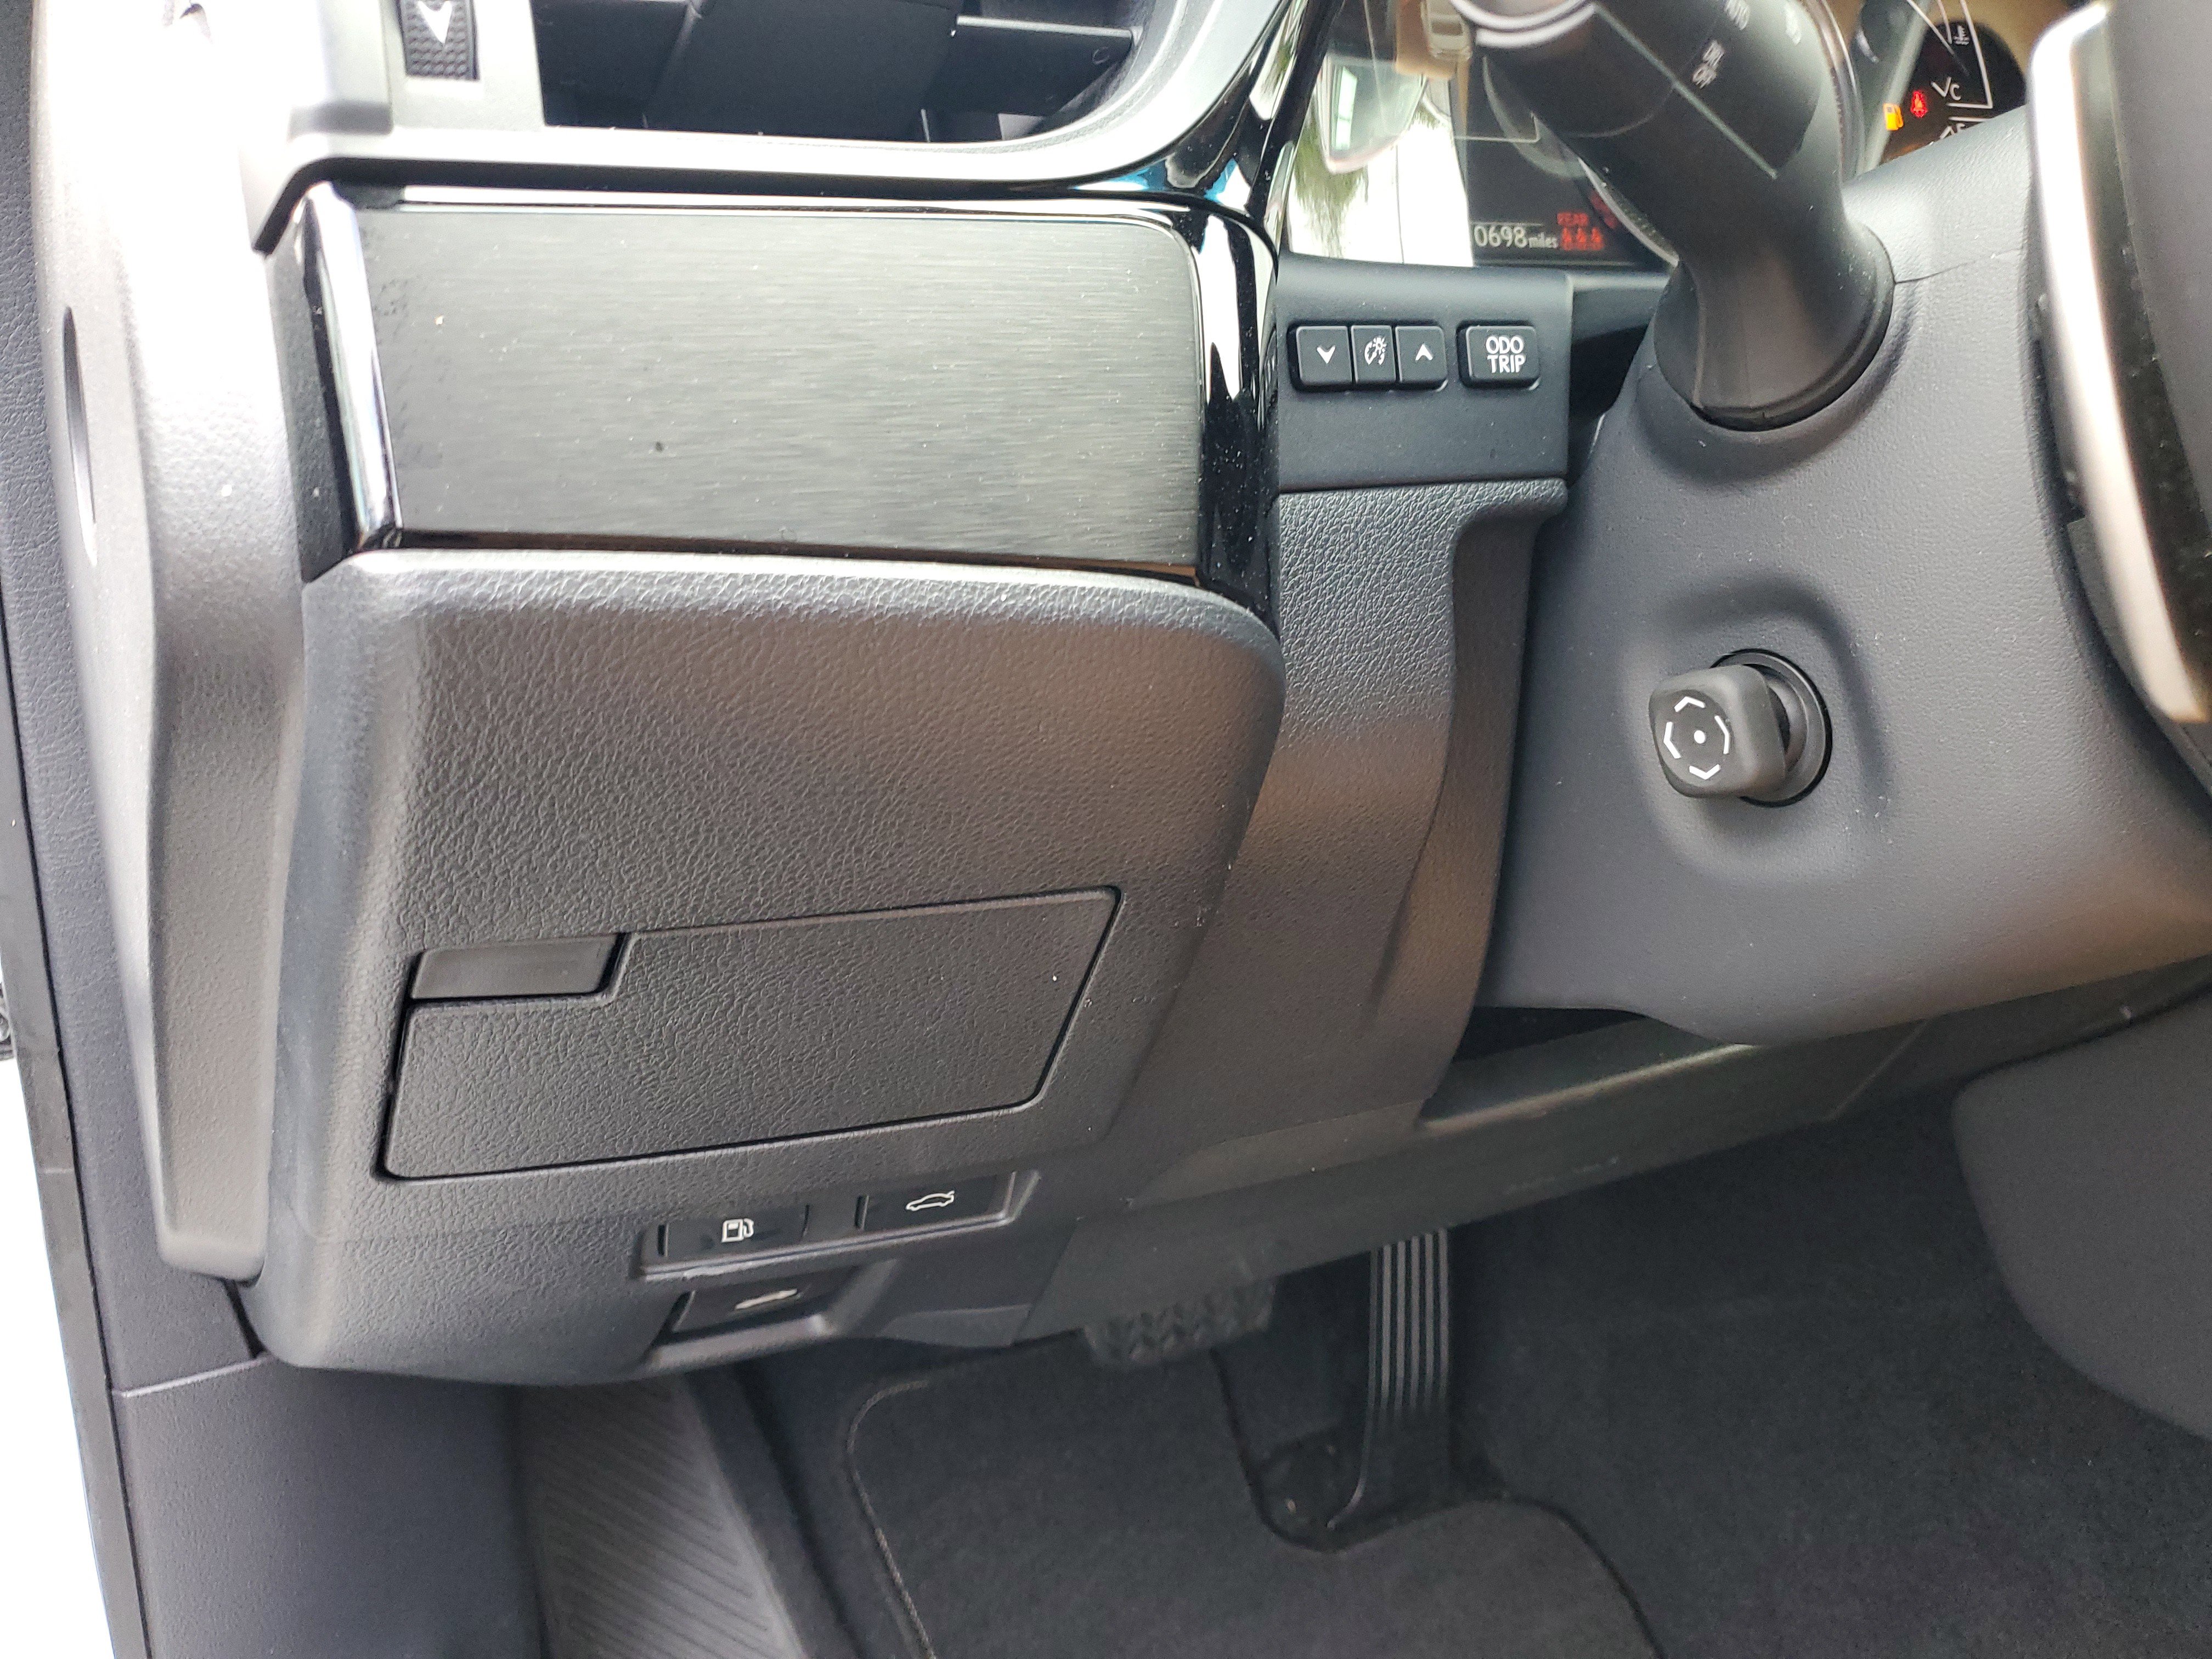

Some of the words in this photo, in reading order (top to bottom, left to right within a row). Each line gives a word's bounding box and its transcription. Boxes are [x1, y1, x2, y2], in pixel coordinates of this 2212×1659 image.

[1474, 226, 1527, 247] 0698
[1529, 232, 1558, 249] miles
[1486, 336, 1523, 354] ODO
[1487, 354, 1526, 373] TRIP
